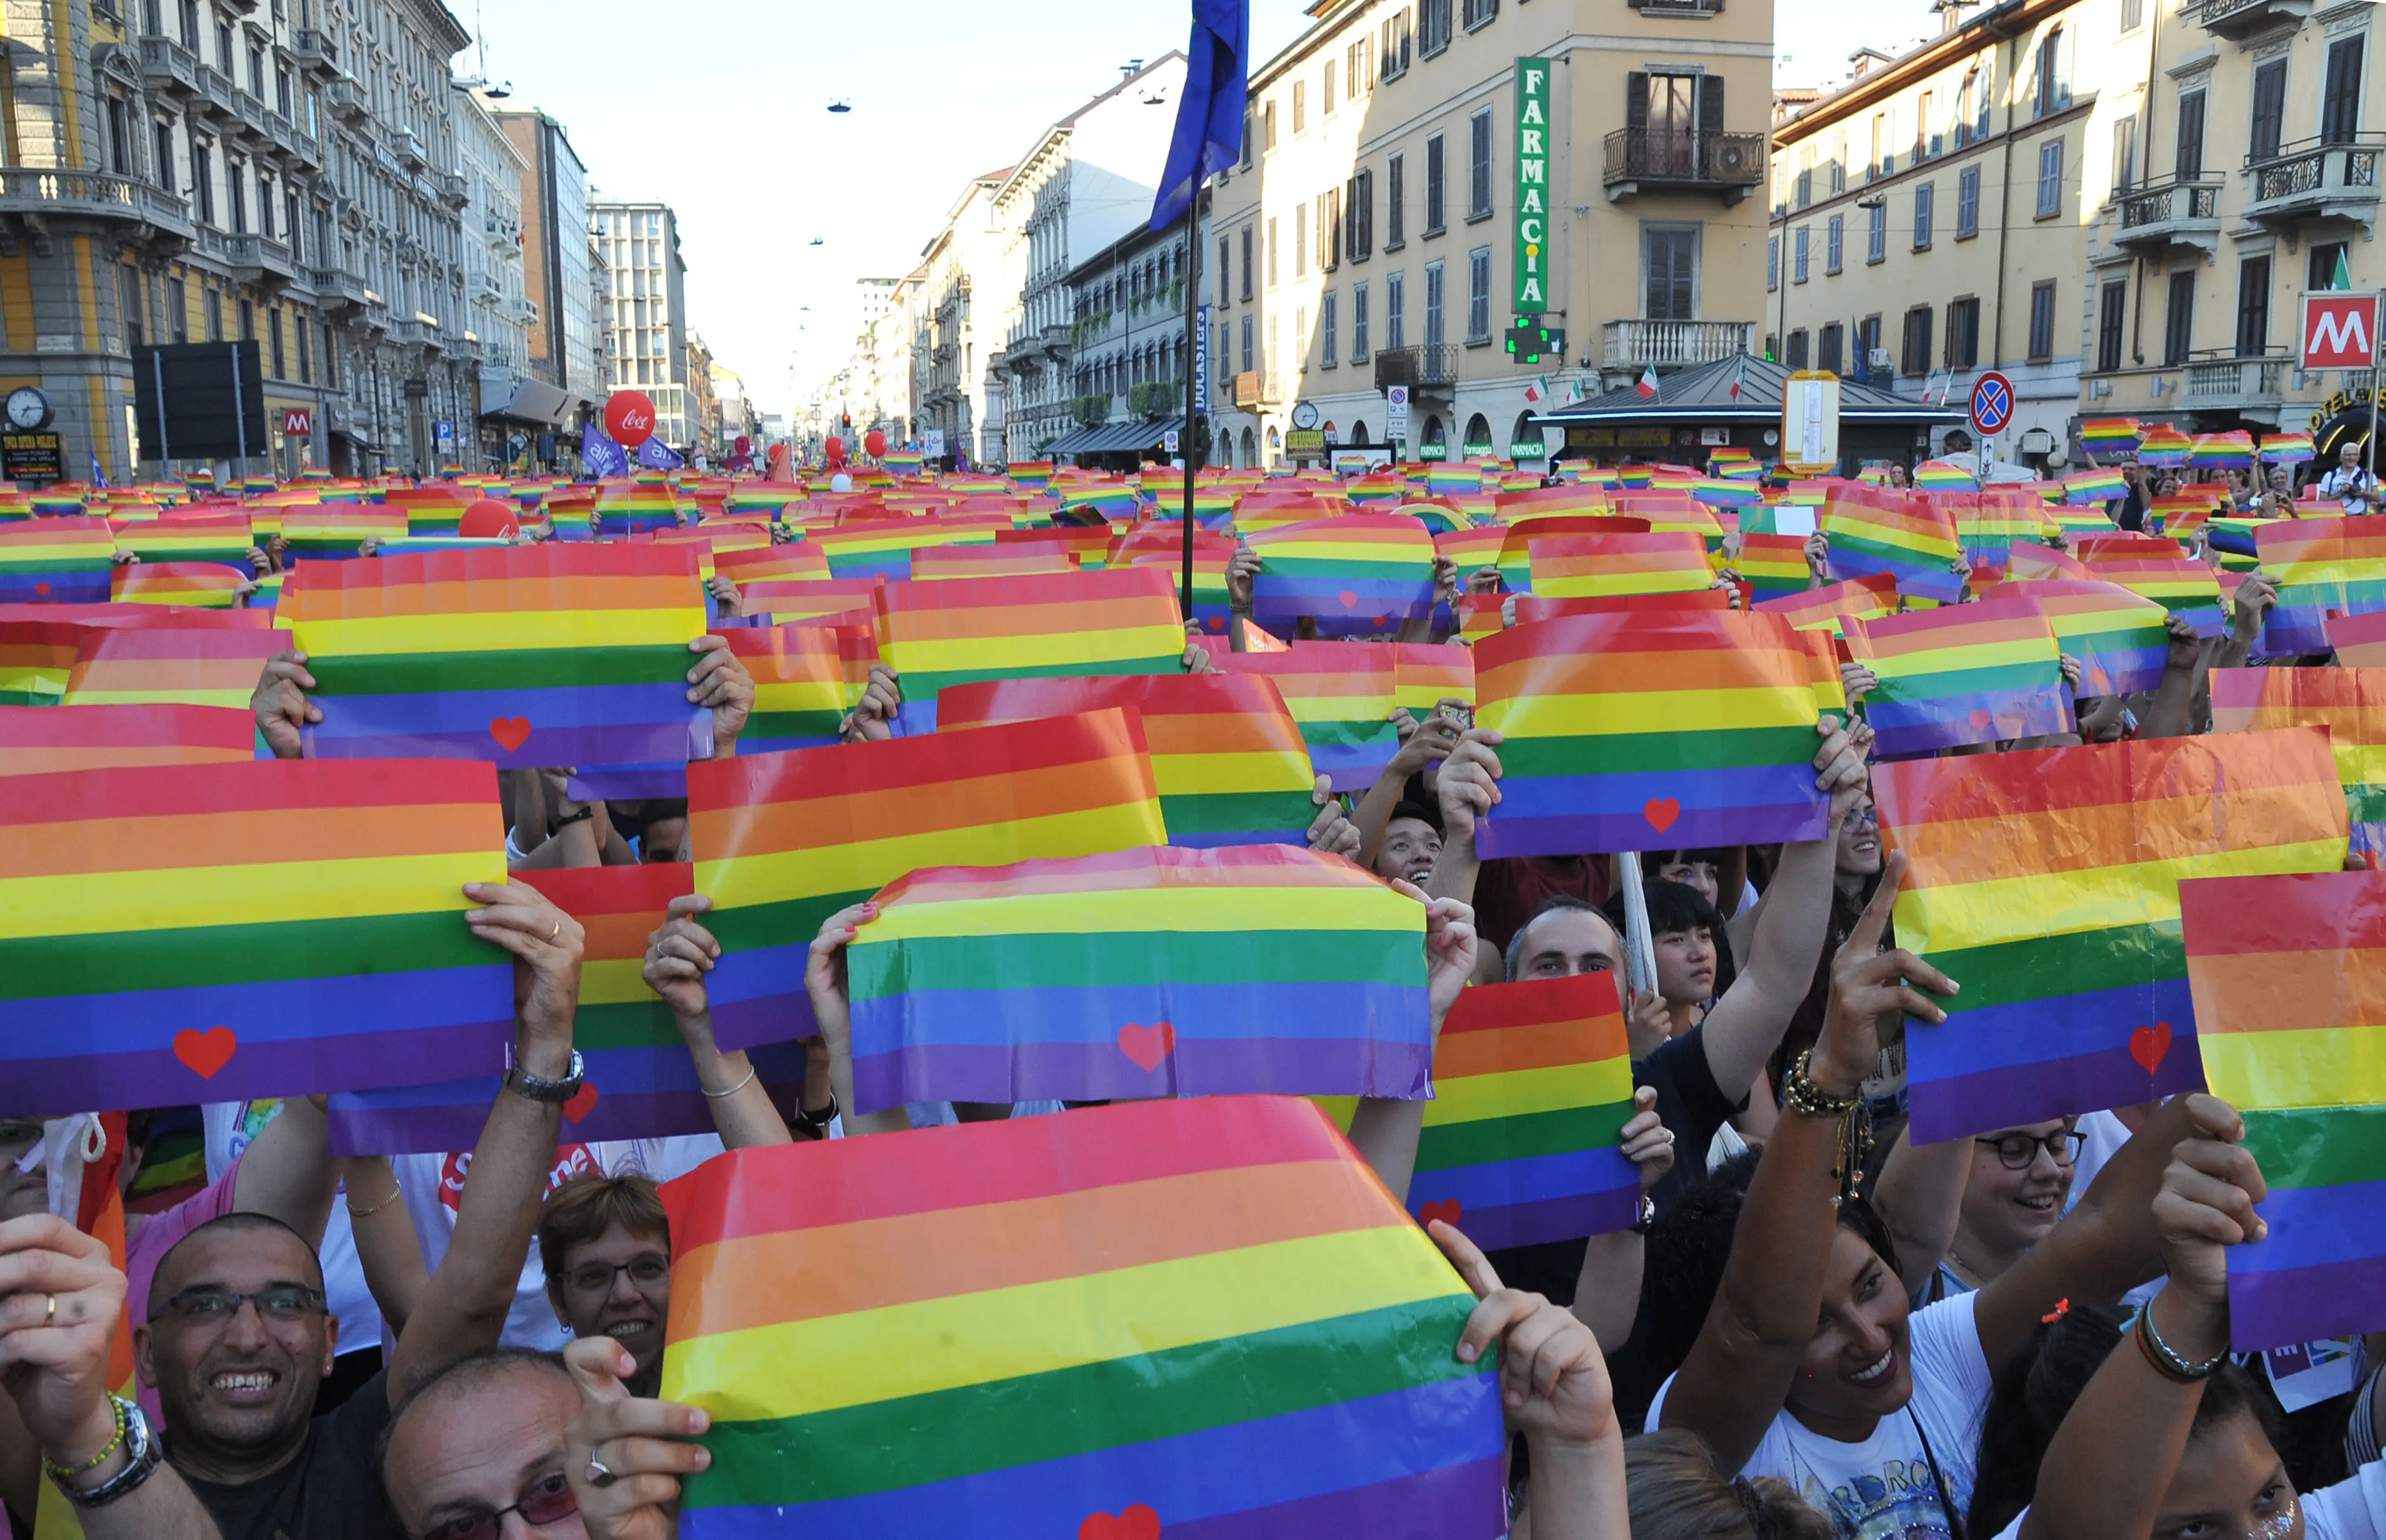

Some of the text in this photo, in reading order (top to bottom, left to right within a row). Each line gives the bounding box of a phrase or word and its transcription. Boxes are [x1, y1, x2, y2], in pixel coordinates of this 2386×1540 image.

[1521, 69, 1545, 302] FARMACIA
[2308, 310, 2369, 354] M
[286, 414, 309, 431] M
[2305, 389, 2354, 432] OTEL
[439, 424, 448, 437] P
[1420, 445, 1445, 456] FARMACIA
[1511, 442, 1544, 455] FARMACIA
[1831, 1459, 1932, 1519] RDRO
